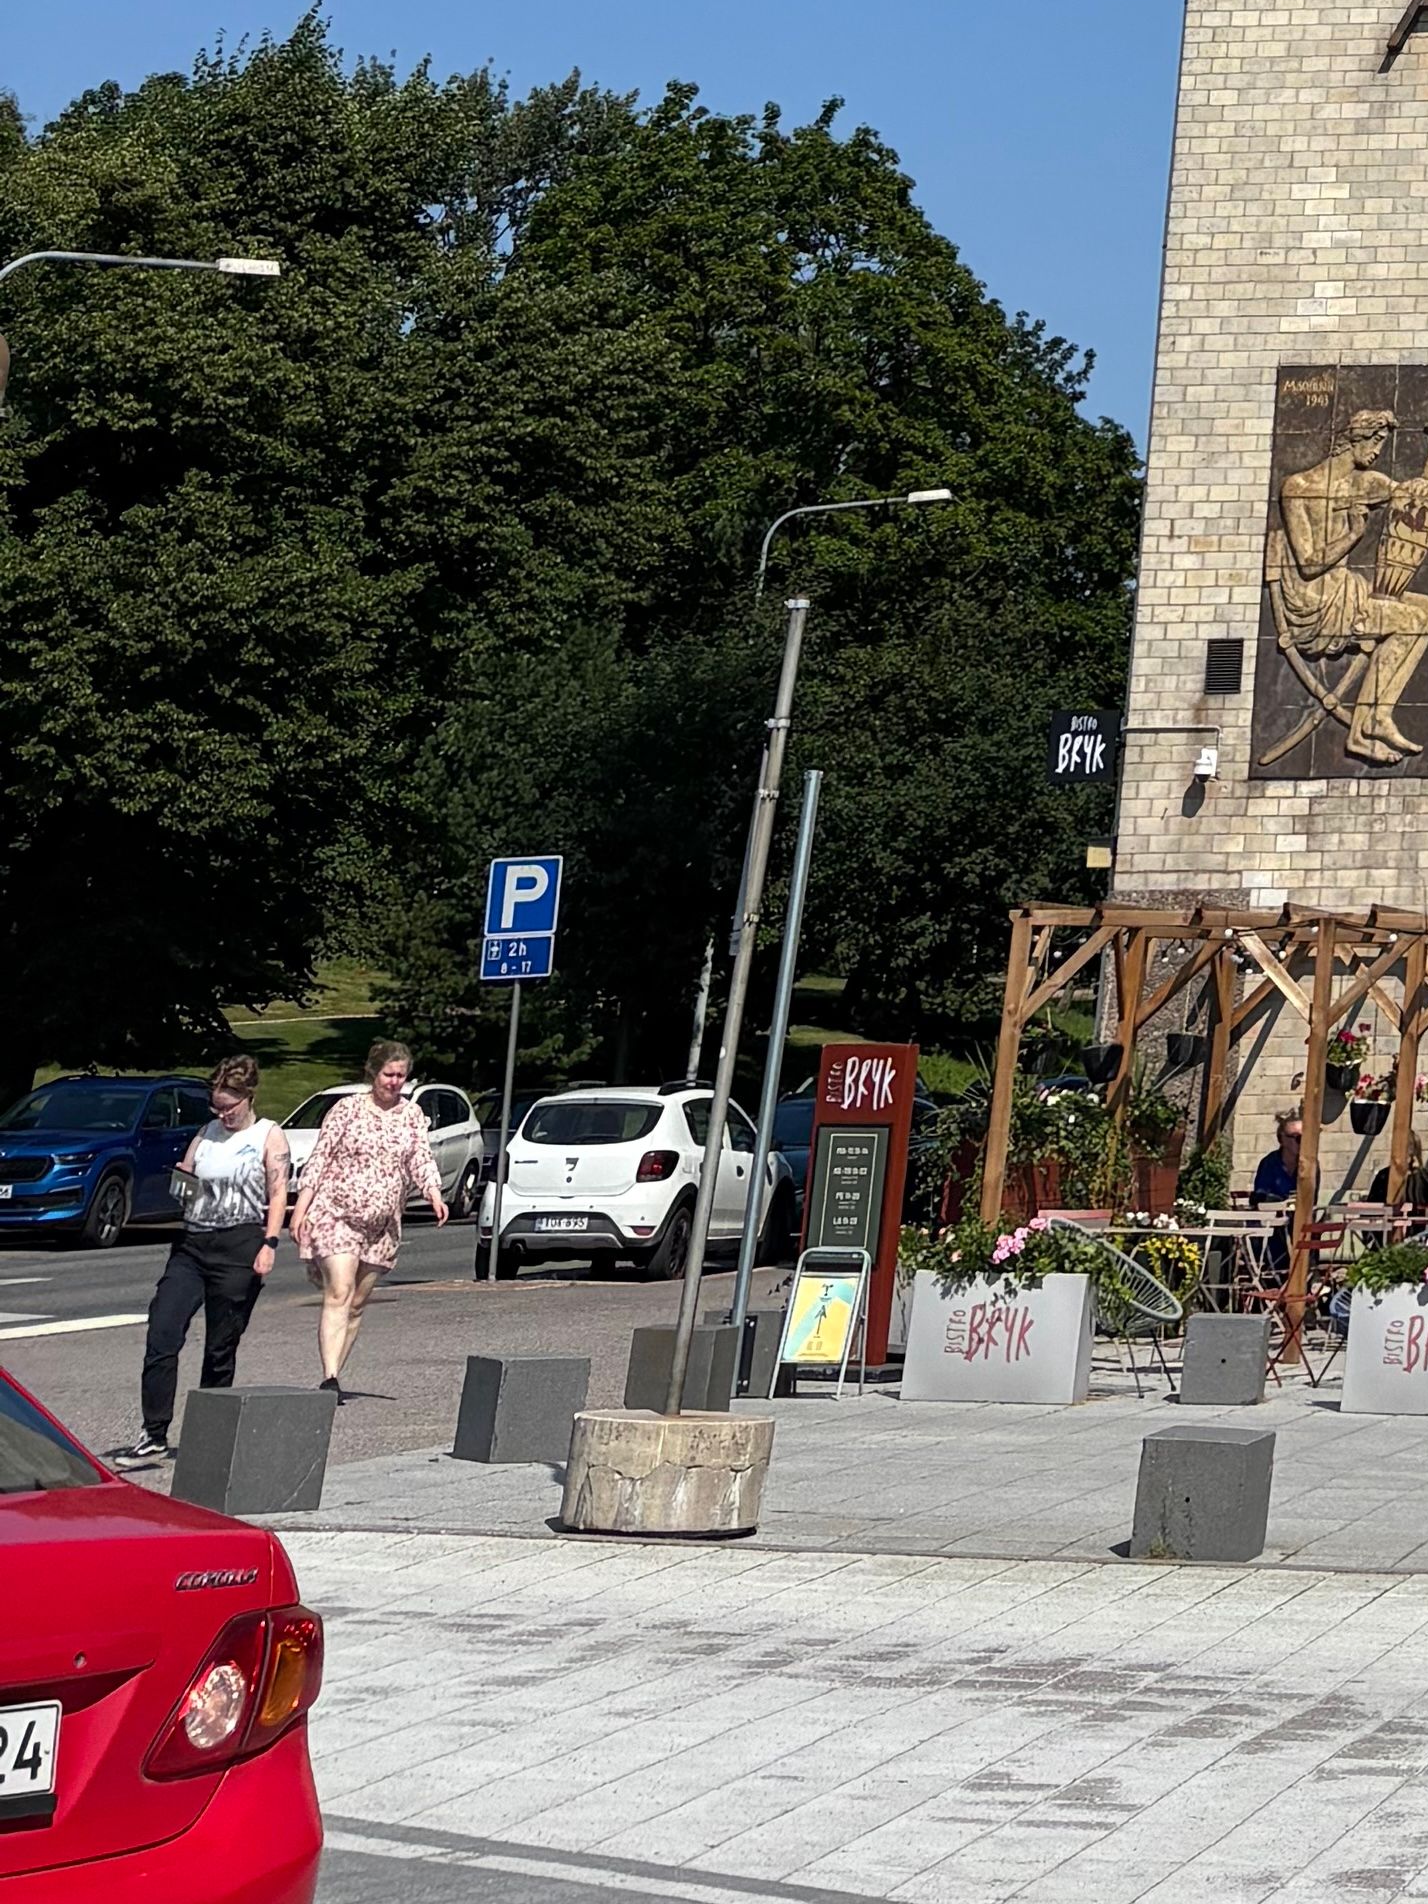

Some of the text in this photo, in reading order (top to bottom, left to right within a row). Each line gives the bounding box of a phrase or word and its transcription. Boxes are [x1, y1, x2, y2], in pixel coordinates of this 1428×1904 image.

[1054, 733, 1106, 774] BRYK
[501, 864, 549, 929] P
[840, 1056, 897, 1111] BRYK
[944, 1302, 1034, 1363] BISTRO BRYK
[1383, 1320, 1405, 1365] BISTRO
